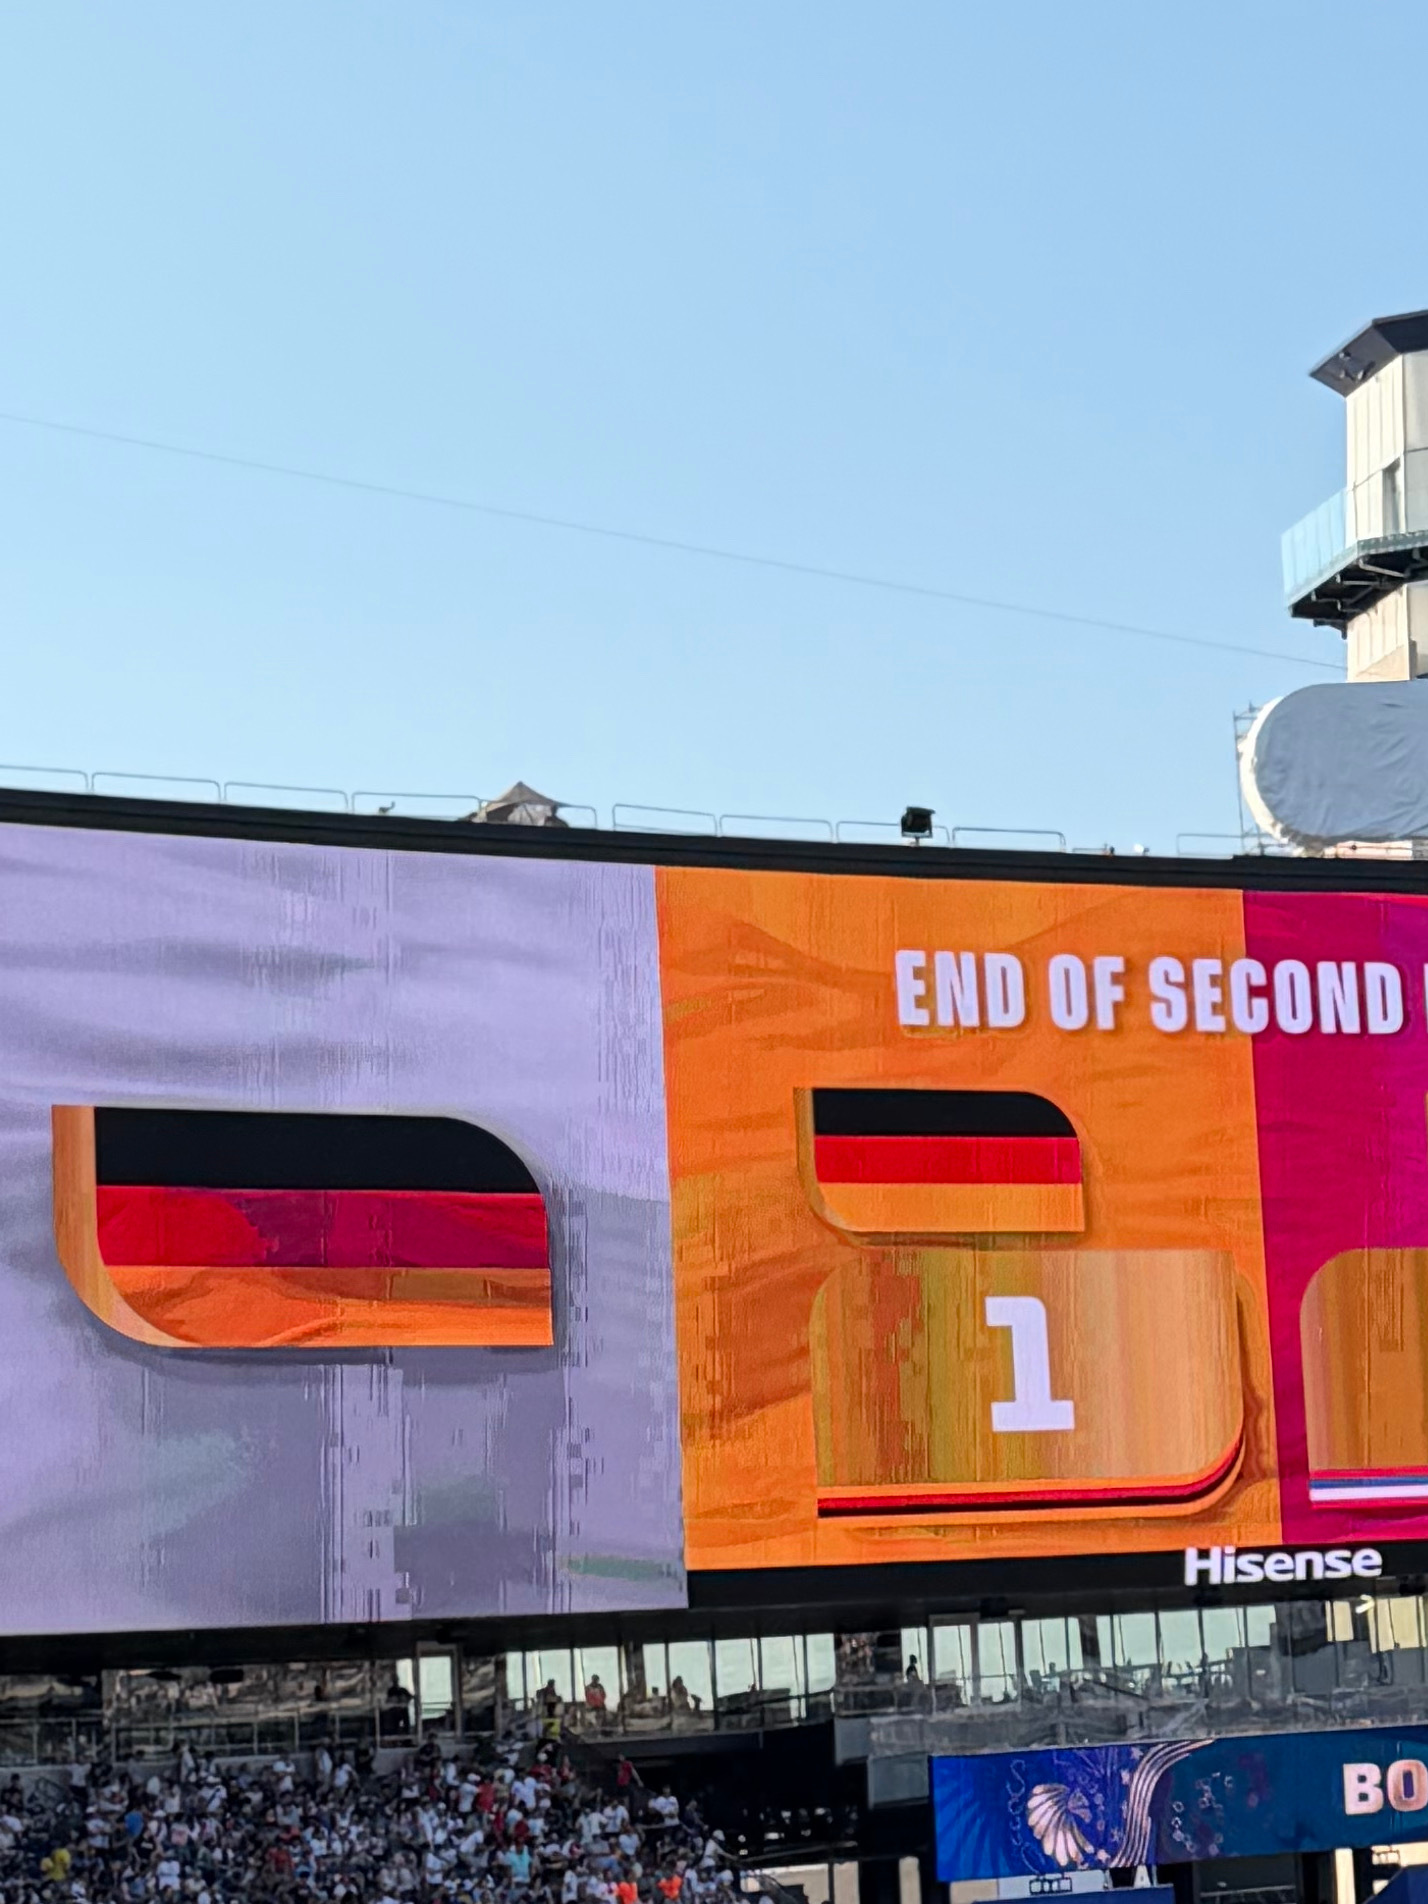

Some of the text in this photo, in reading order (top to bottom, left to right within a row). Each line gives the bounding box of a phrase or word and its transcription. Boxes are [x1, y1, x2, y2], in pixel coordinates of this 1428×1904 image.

[895, 949, 1026, 1028] END
[1048, 953, 1125, 1030] OF
[1148, 956, 1404, 1035] SECOND
[985, 1296, 1075, 1432] 1
[1184, 1545, 1383, 1587] Hisense
